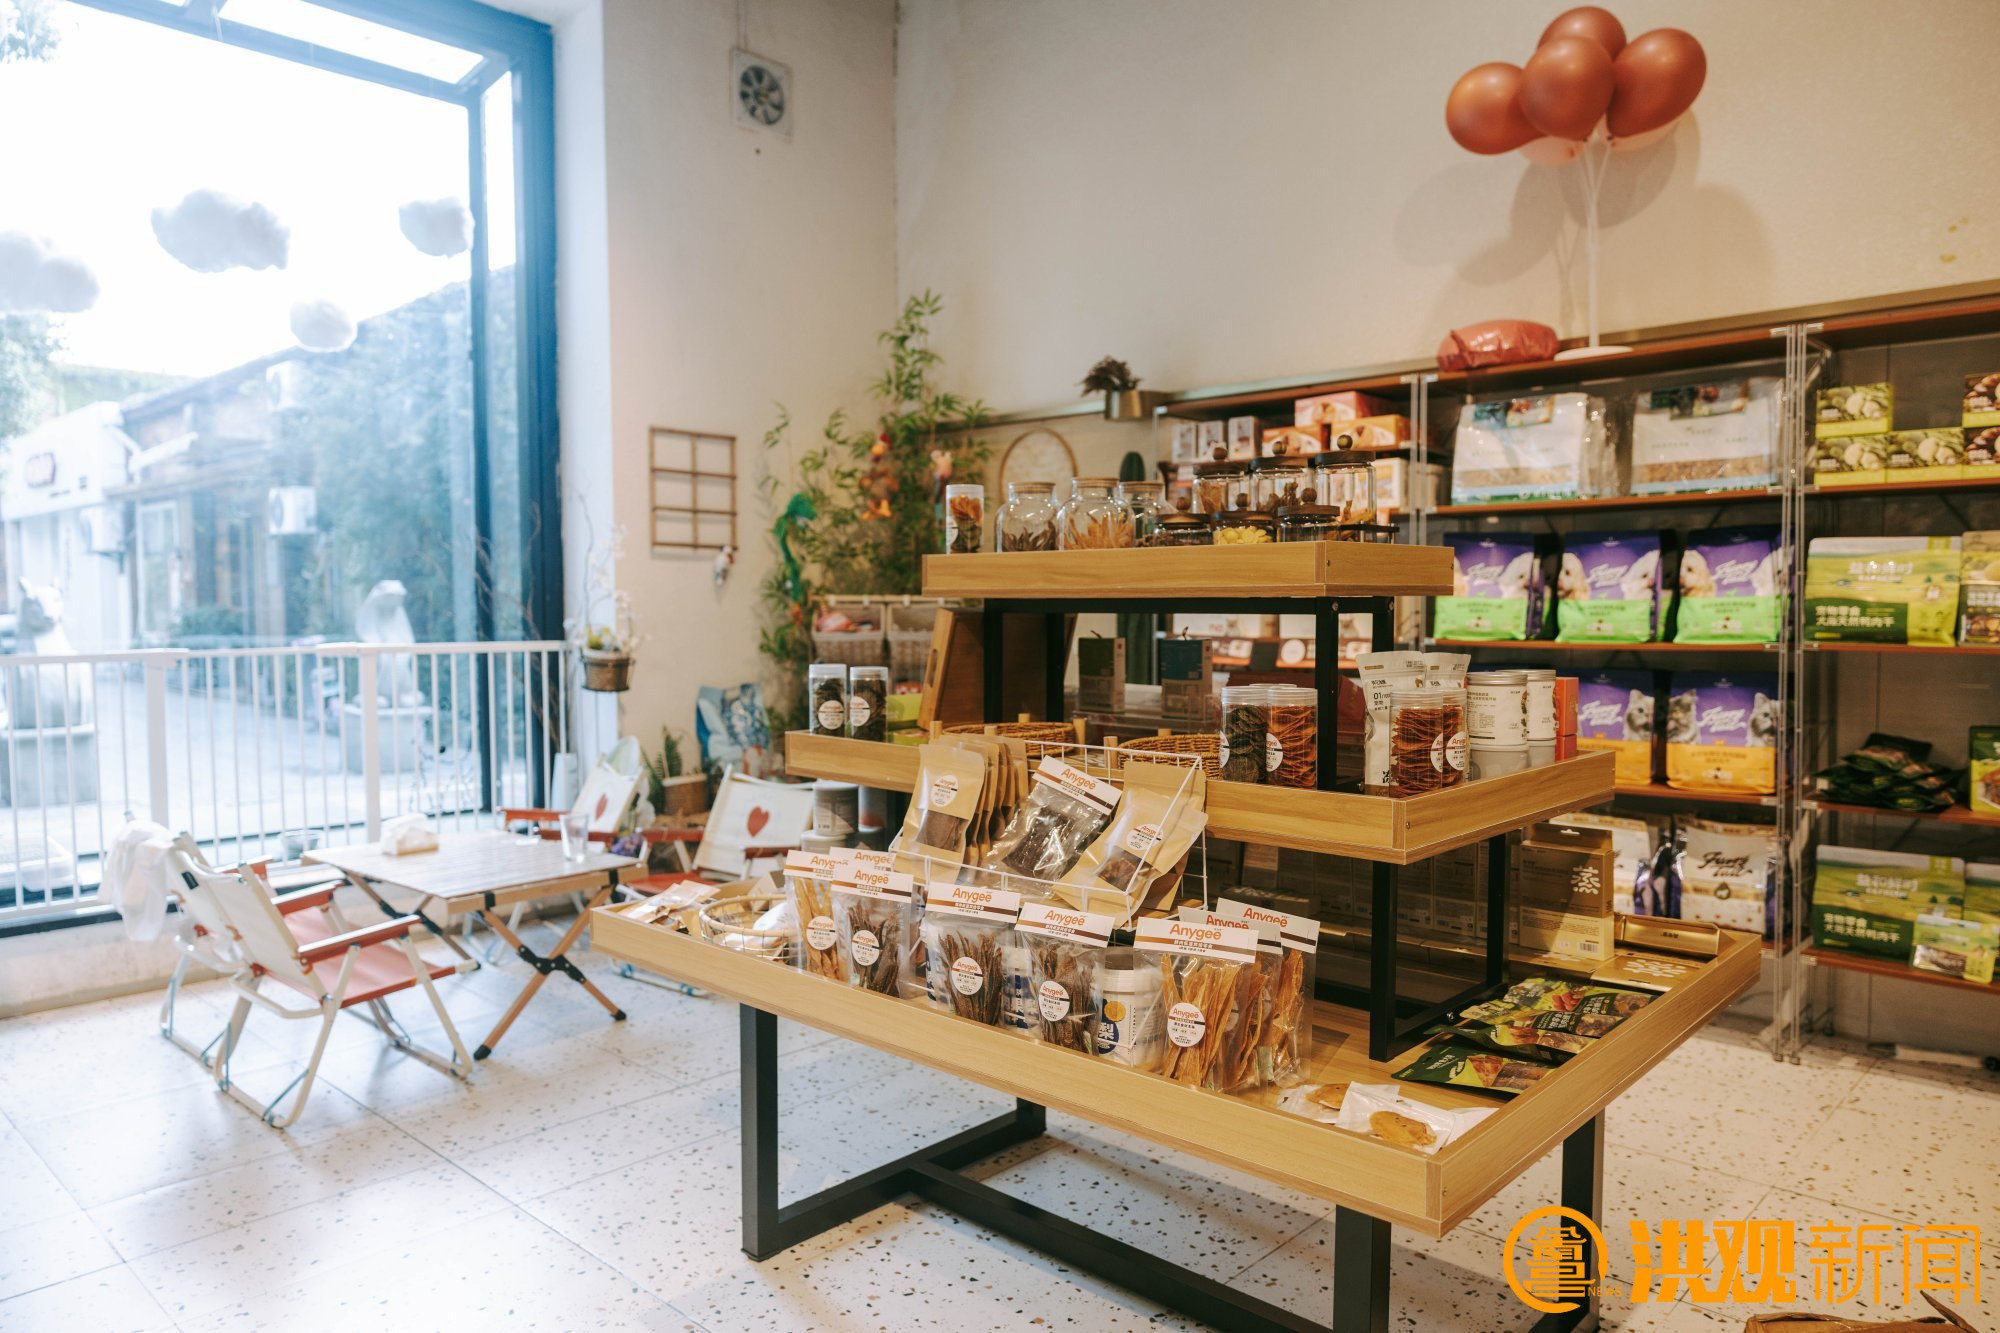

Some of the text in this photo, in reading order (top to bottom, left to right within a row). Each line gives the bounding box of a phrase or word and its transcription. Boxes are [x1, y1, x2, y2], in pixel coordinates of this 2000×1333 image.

[1061, 768, 1096, 790] Anygee
[854, 869, 889, 885] Anygee
[952, 887, 992, 903] Anygee
[1044, 909, 1085, 926] Anygee
[1169, 923, 1222, 940] Anygee
